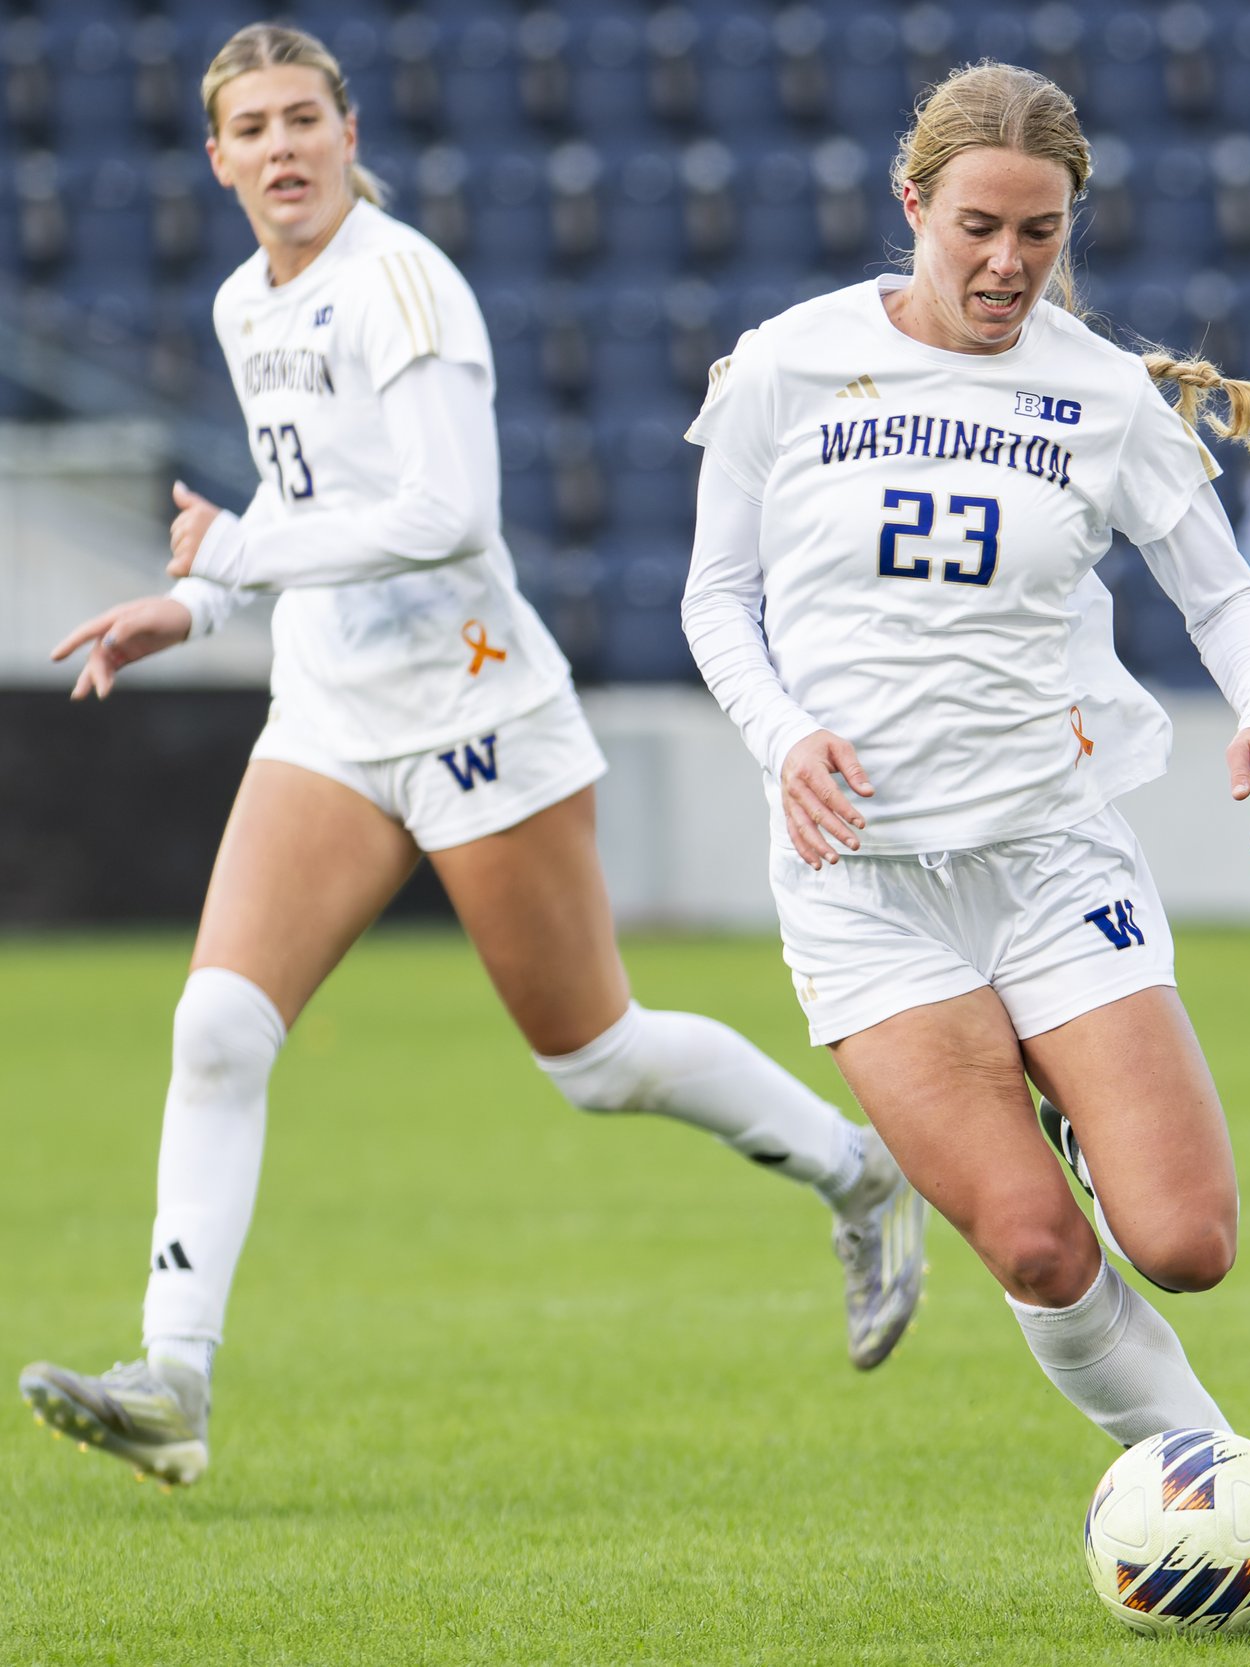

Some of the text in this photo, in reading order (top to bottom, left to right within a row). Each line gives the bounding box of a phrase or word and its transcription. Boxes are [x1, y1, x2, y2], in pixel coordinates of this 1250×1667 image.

[257, 423, 314, 500] 33
[820, 415, 1073, 490] WASHINGTON
[877, 487, 1002, 588] 23
[438, 733, 497, 792] W
[1083, 899, 1145, 951] W
